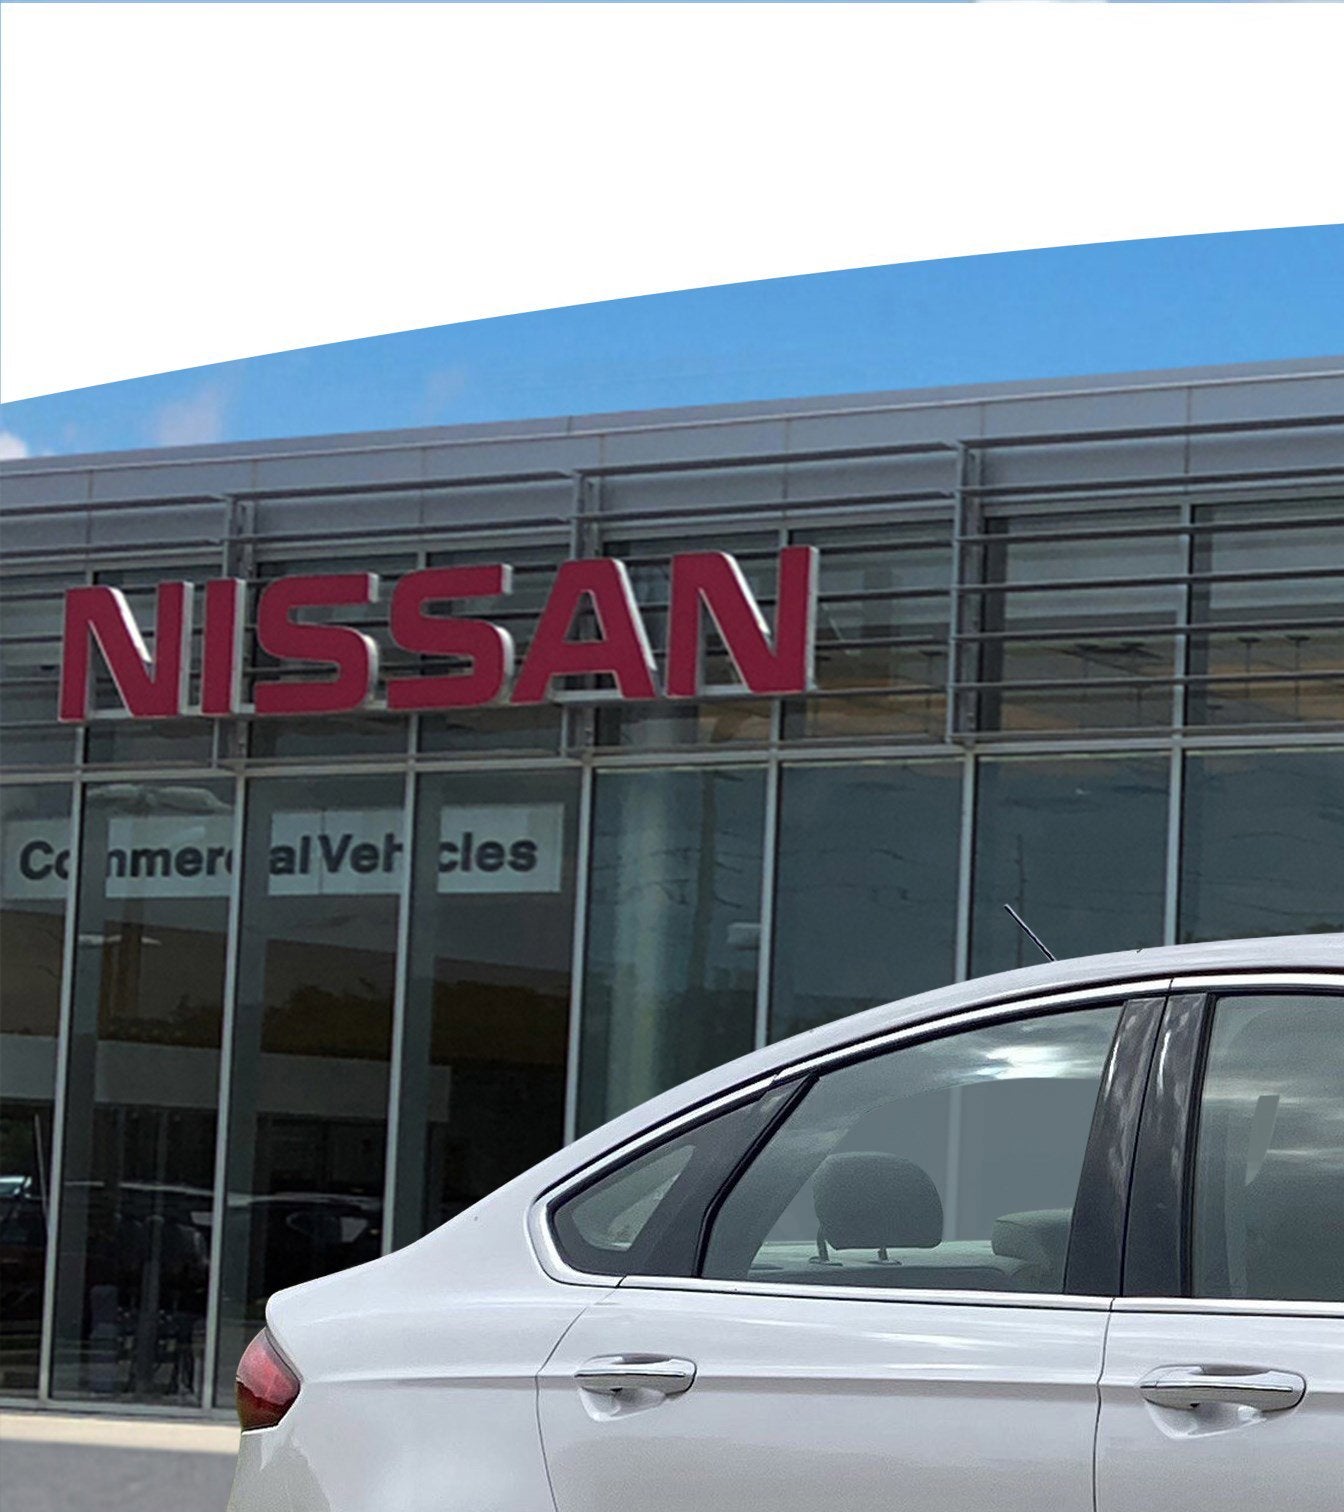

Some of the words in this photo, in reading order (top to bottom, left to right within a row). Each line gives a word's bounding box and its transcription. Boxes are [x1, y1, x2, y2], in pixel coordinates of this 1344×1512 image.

[59, 546, 818, 722] NISSAN
[20, 834, 311, 881] Commeral
[318, 831, 538, 874] Vehcles
